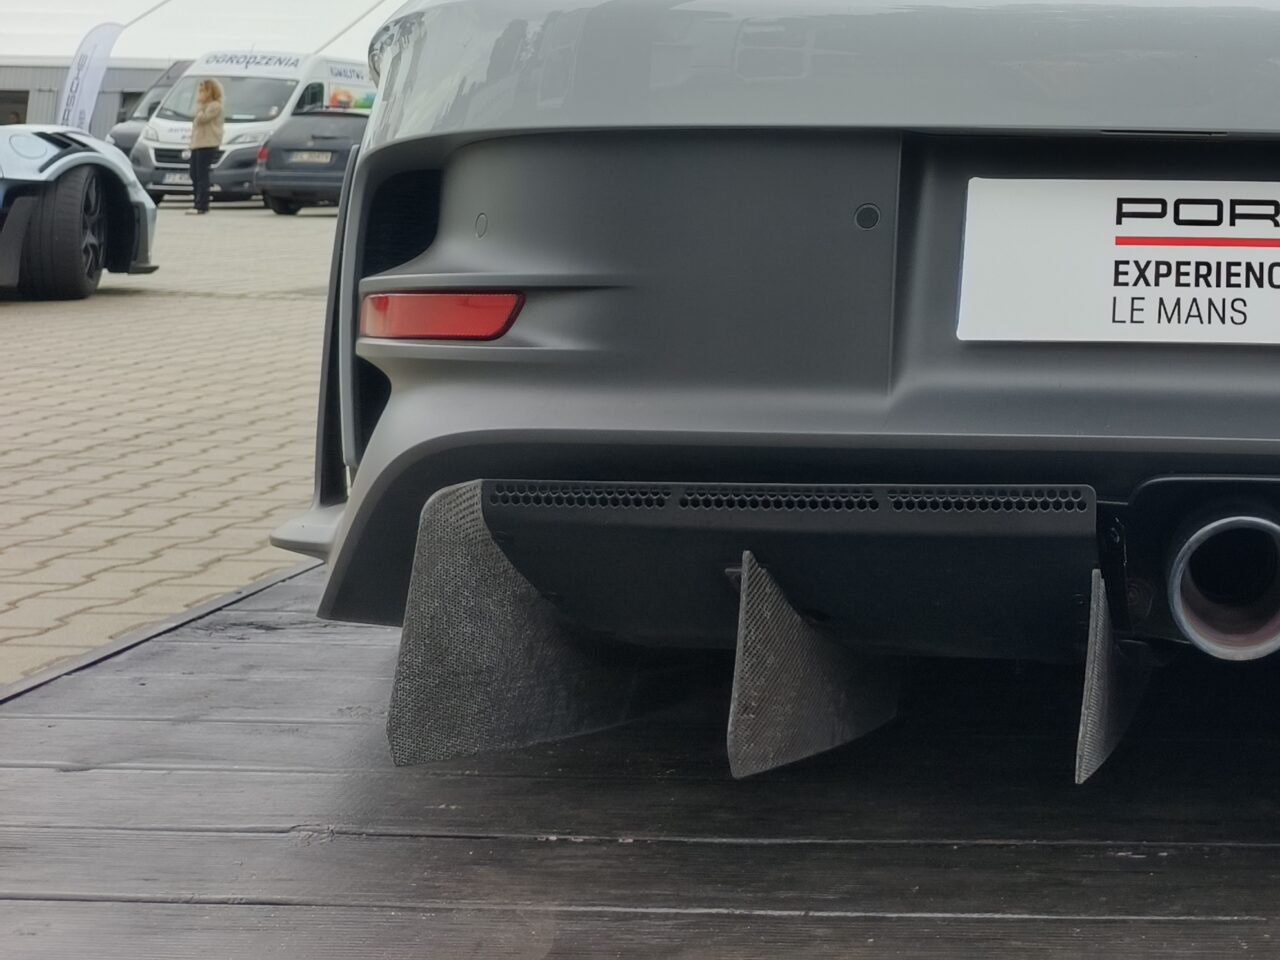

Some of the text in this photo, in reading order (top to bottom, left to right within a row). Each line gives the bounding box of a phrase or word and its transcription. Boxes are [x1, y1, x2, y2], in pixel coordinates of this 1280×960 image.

[205, 54, 301, 68] OGRODZENIA
[61, 54, 88, 126] RSCHE
[1111, 296, 1248, 326] LE MANS
